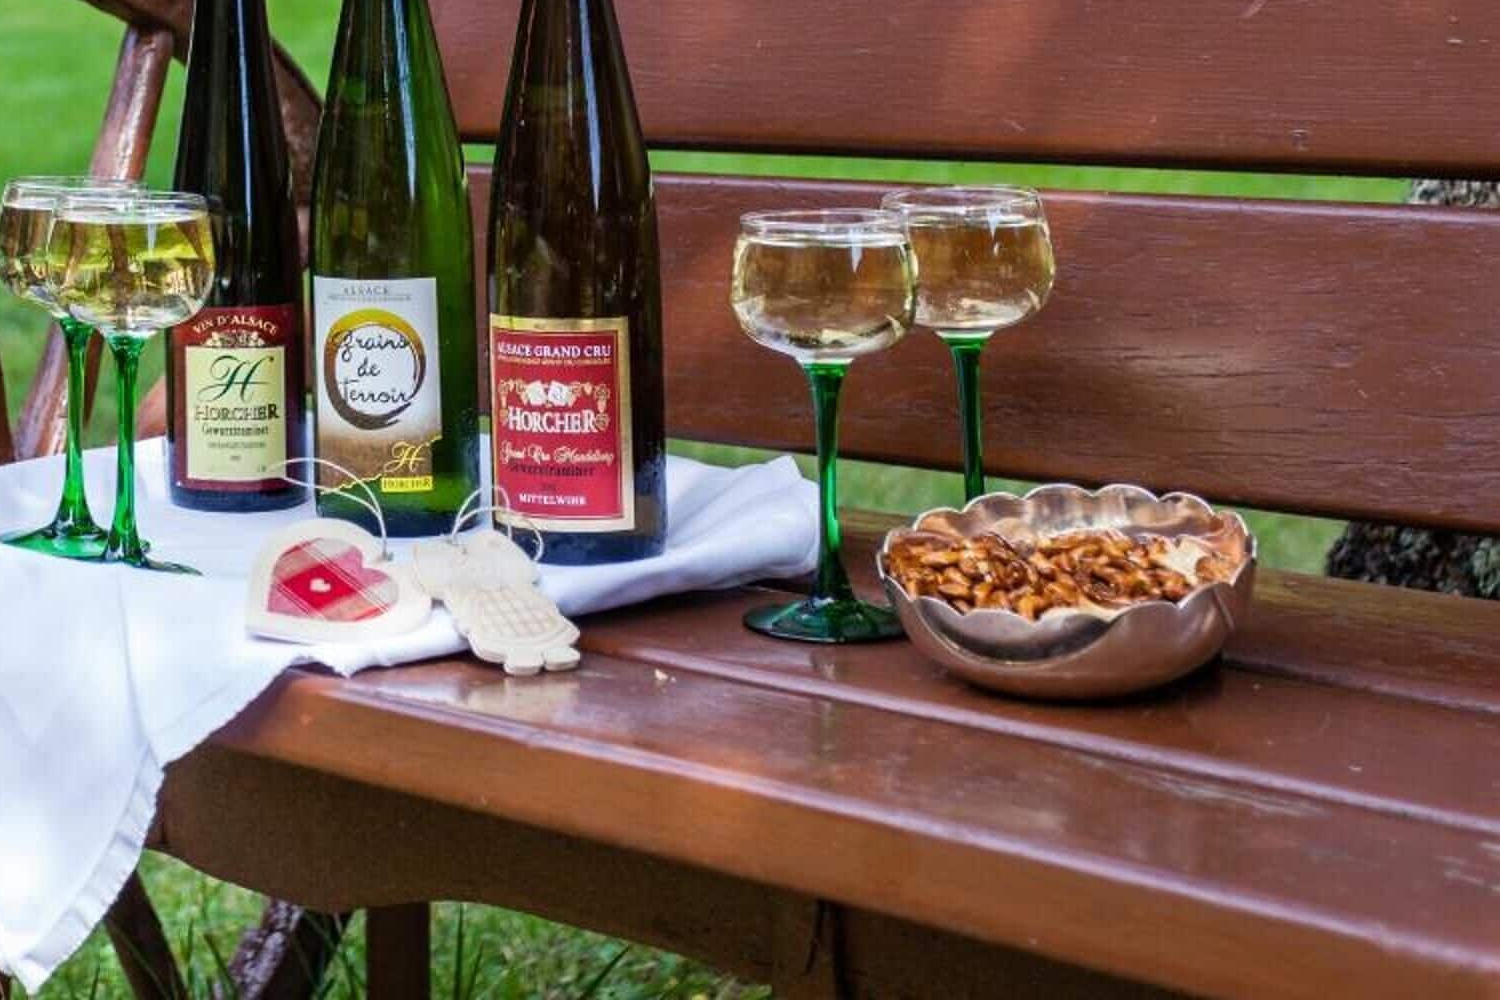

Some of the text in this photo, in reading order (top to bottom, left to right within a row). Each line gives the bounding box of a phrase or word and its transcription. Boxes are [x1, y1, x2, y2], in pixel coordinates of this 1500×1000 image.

[343, 286, 390, 296] ALSACE
[193, 314, 279, 336] VIN D'ALSACE
[534, 344, 581, 358] GRAND
[584, 344, 612, 357] CRU
[356, 357, 381, 377] de
[197, 355, 274, 403] H
[195, 403, 280, 421] HORCHER
[507, 405, 599, 433] HORCHER
[383, 441, 428, 473] H
